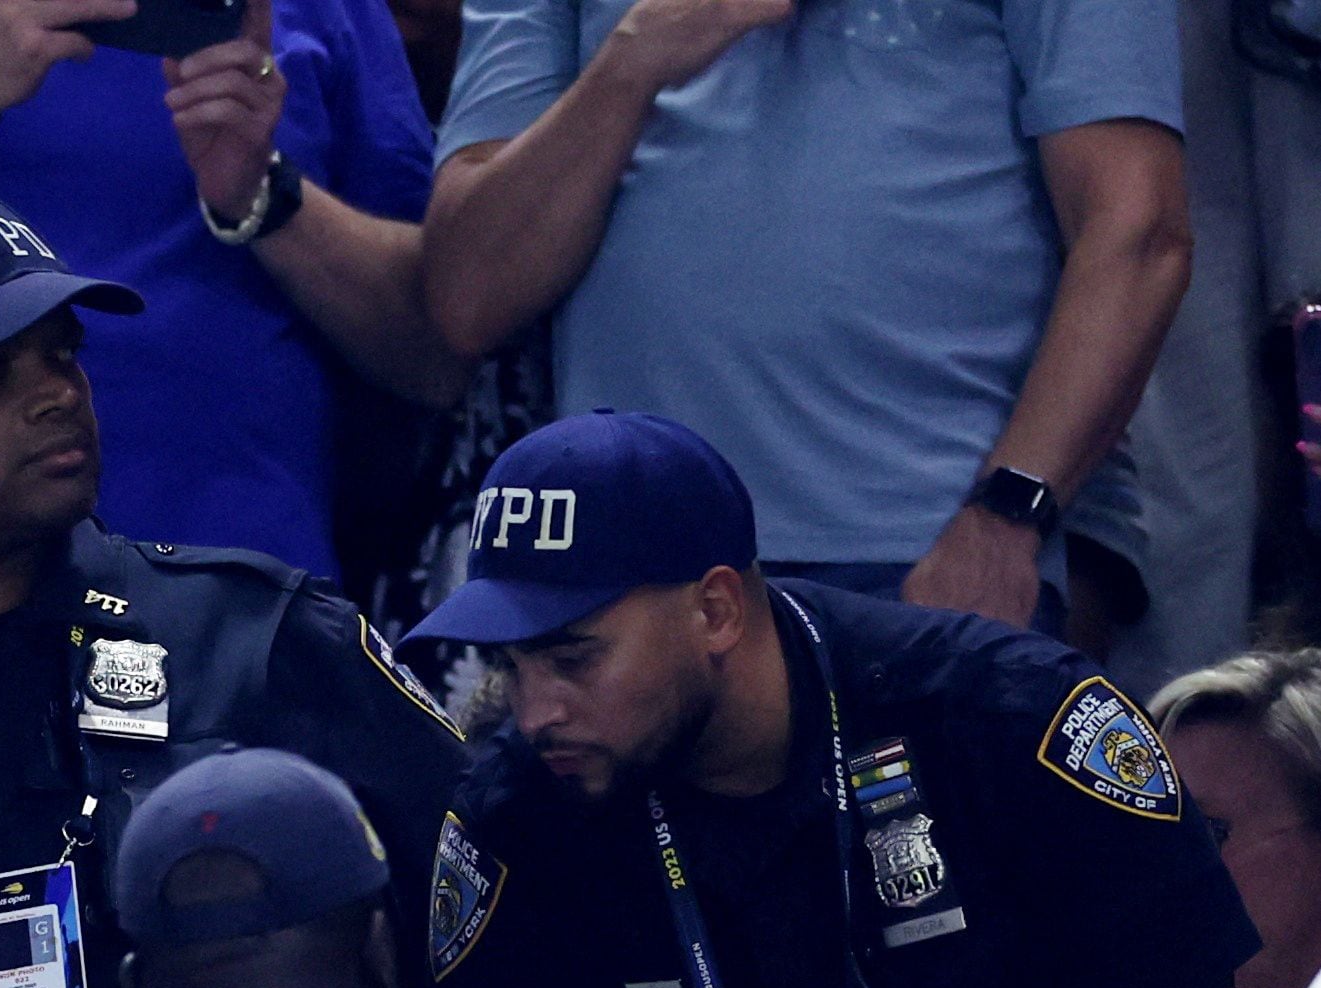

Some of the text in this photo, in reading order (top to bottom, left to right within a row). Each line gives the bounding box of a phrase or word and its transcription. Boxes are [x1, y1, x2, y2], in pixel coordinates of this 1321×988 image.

[100, 718, 147, 731] RAHMAN
[1061, 693, 1101, 740] POLICE
[833, 735, 843, 760] US
[1065, 697, 1124, 772] DEPARTMENT
[1132, 713, 1177, 795] NEW YORK
[835, 763, 848, 811] OPEN
[1094, 780, 1157, 809] CITY OF
[655, 822, 672, 845] US
[662, 848, 686, 890] 2023
[34, 921, 49, 936] G
[458, 907, 487, 944] YORK
[41, 940, 50, 954] 1
